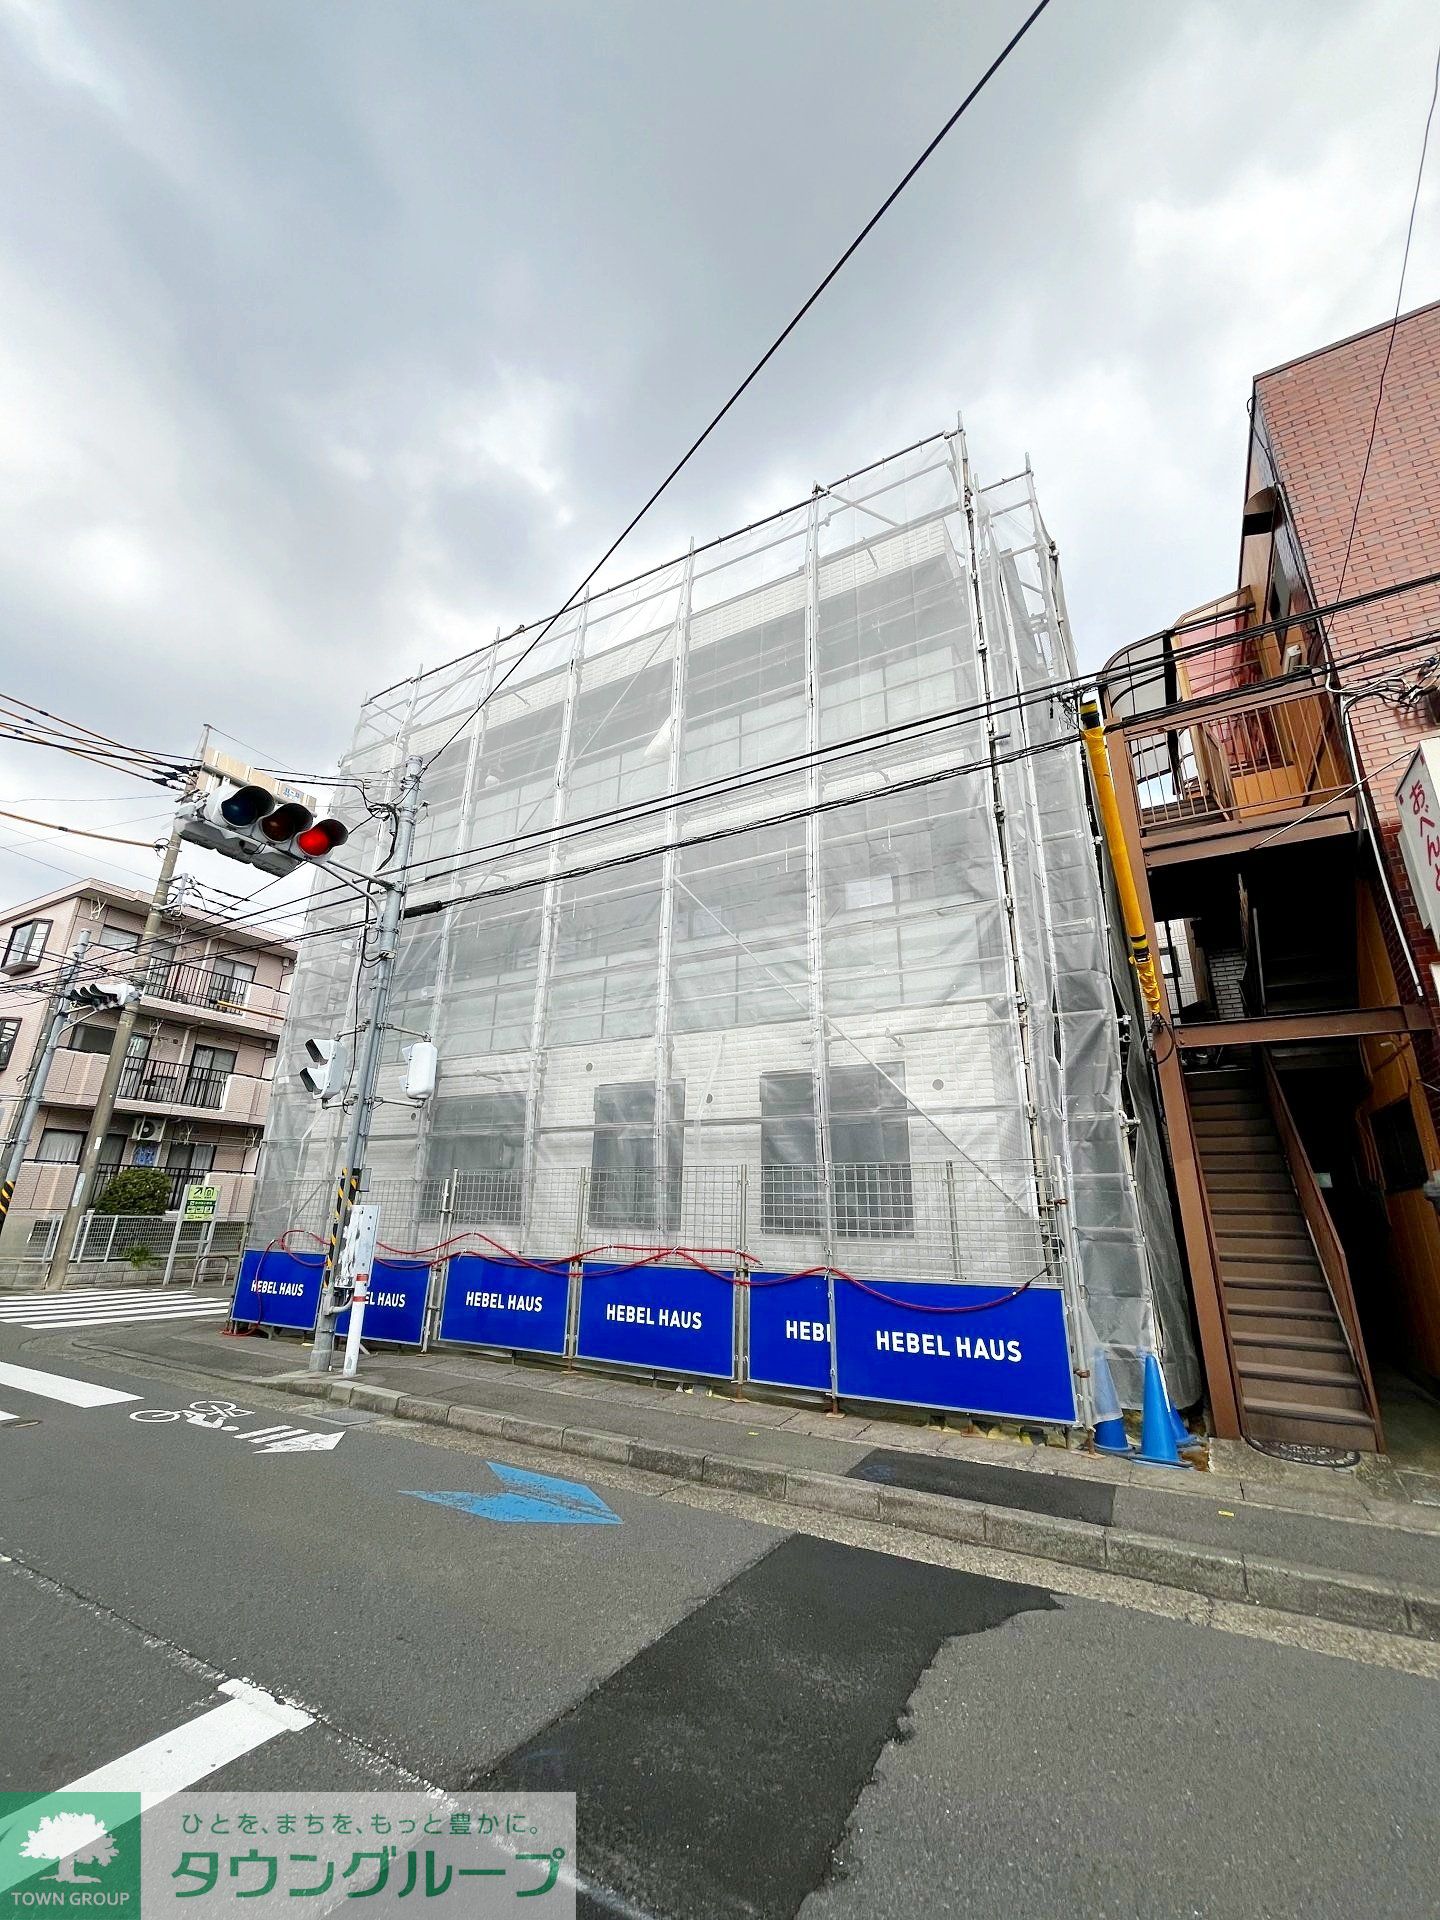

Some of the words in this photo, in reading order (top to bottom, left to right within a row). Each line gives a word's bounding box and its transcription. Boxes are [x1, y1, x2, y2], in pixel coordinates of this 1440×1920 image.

[250, 1280, 277, 1295] HEBEL
[279, 1282, 304, 1297] HAUS
[377, 1291, 406, 1308] HAUS
[465, 1291, 505, 1309] HEBEL
[507, 1294, 543, 1313] HAUS
[606, 1303, 655, 1325] HEBEL
[658, 1308, 702, 1330] HAUS
[785, 1319, 831, 1343] HEB
[876, 1330, 951, 1357] HEBEL
[955, 1336, 1022, 1363] HAUS
